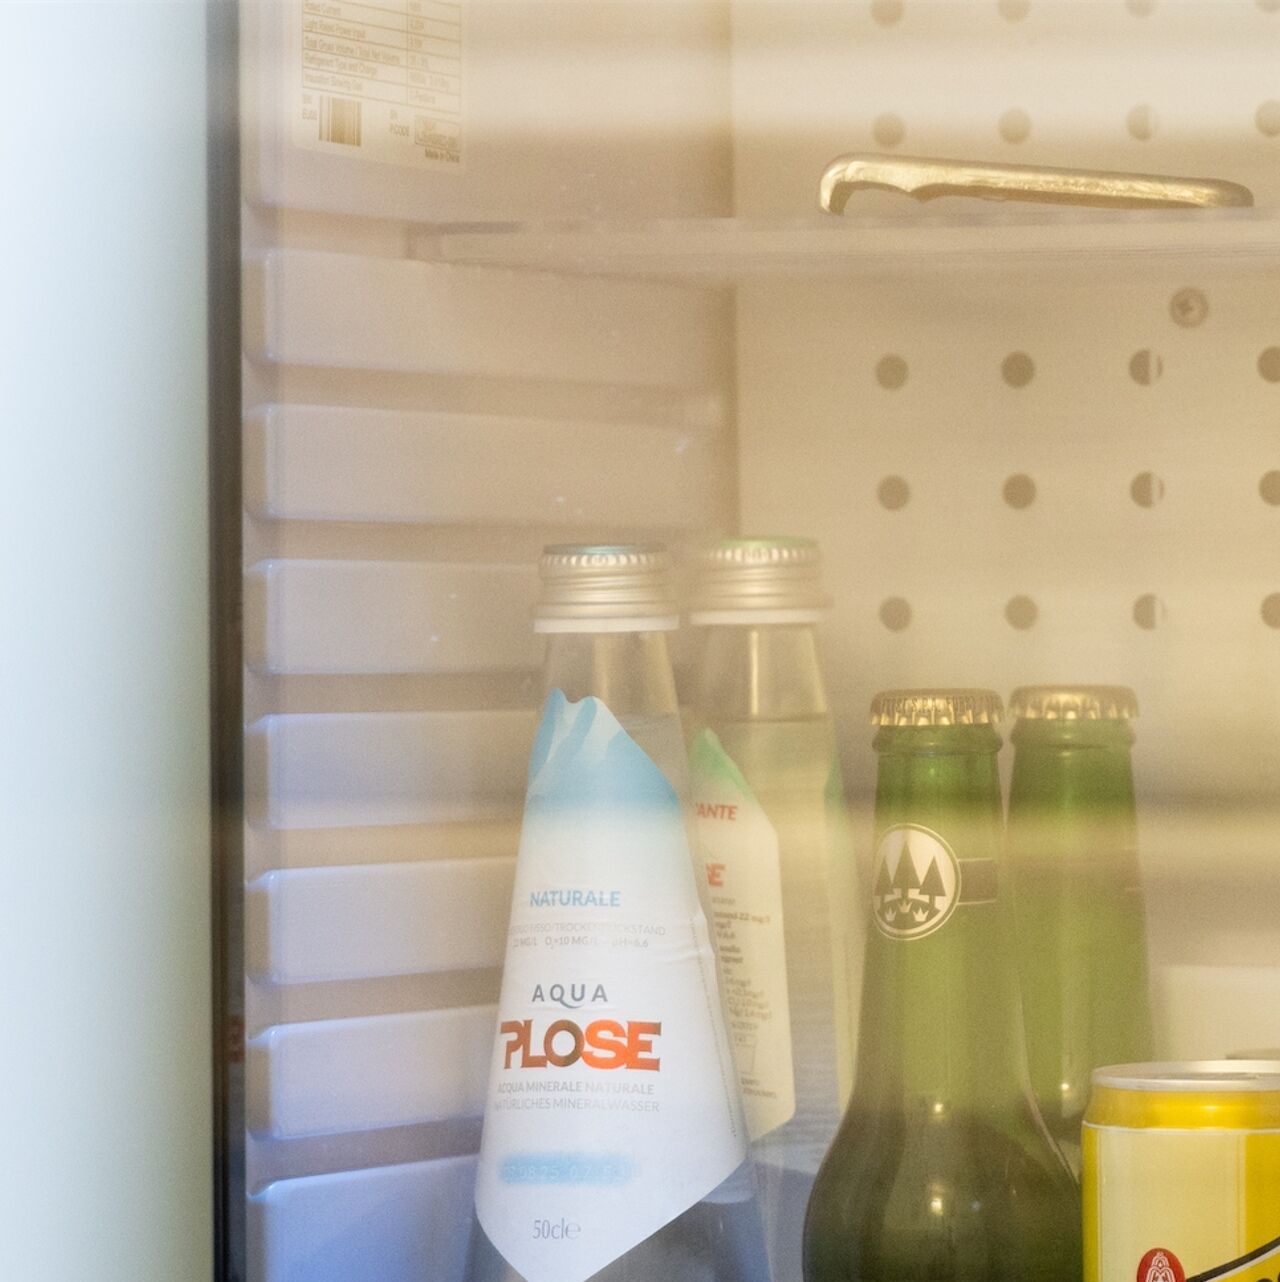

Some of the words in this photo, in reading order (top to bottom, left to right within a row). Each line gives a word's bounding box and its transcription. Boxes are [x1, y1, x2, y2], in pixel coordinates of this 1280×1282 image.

[696, 802, 738, 821] ANTE
[530, 890, 621, 907] NATURALE
[531, 983, 608, 1009] AQUA
[500, 1019, 662, 1072] PLOSE
[526, 1080, 583, 1093] MINERALE
[585, 1081, 655, 1096] NATURALE
[553, 1097, 660, 1113] MINERALWASSER
